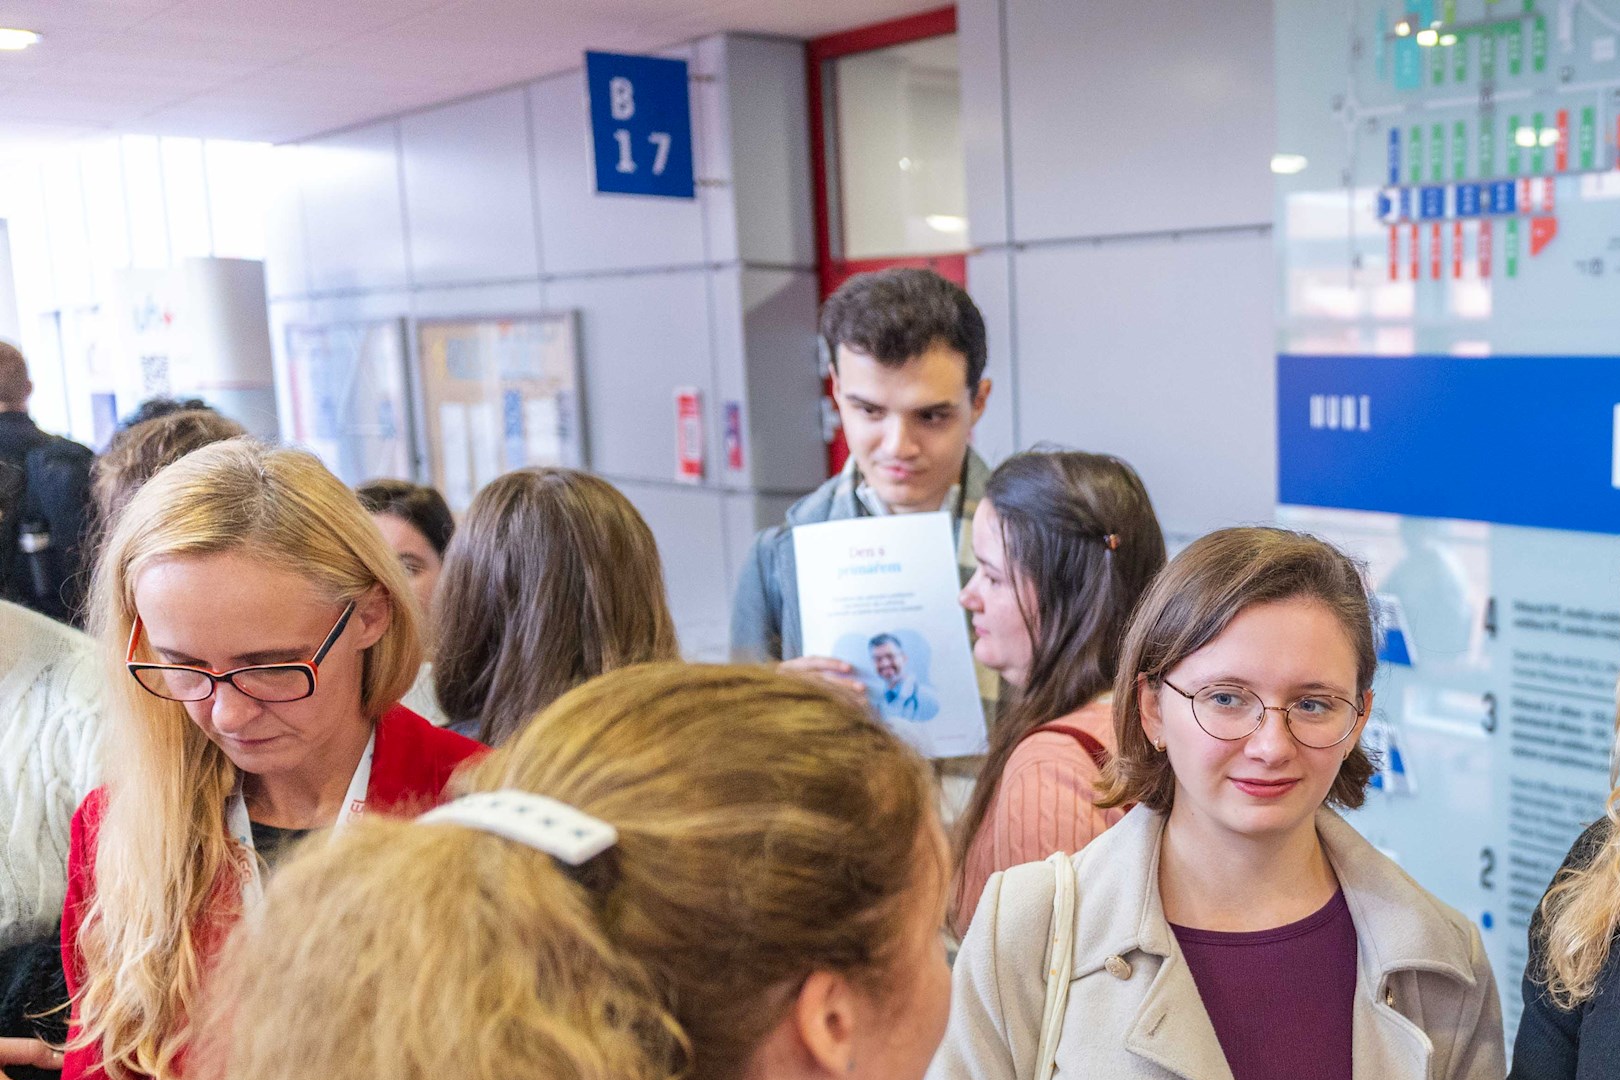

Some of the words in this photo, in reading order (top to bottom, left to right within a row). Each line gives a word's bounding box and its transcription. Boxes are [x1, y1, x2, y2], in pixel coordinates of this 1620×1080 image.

[609, 76, 635, 121] B
[613, 128, 672, 176] 17
[1481, 694, 1497, 734] 3
[1480, 849, 1496, 889] 2
